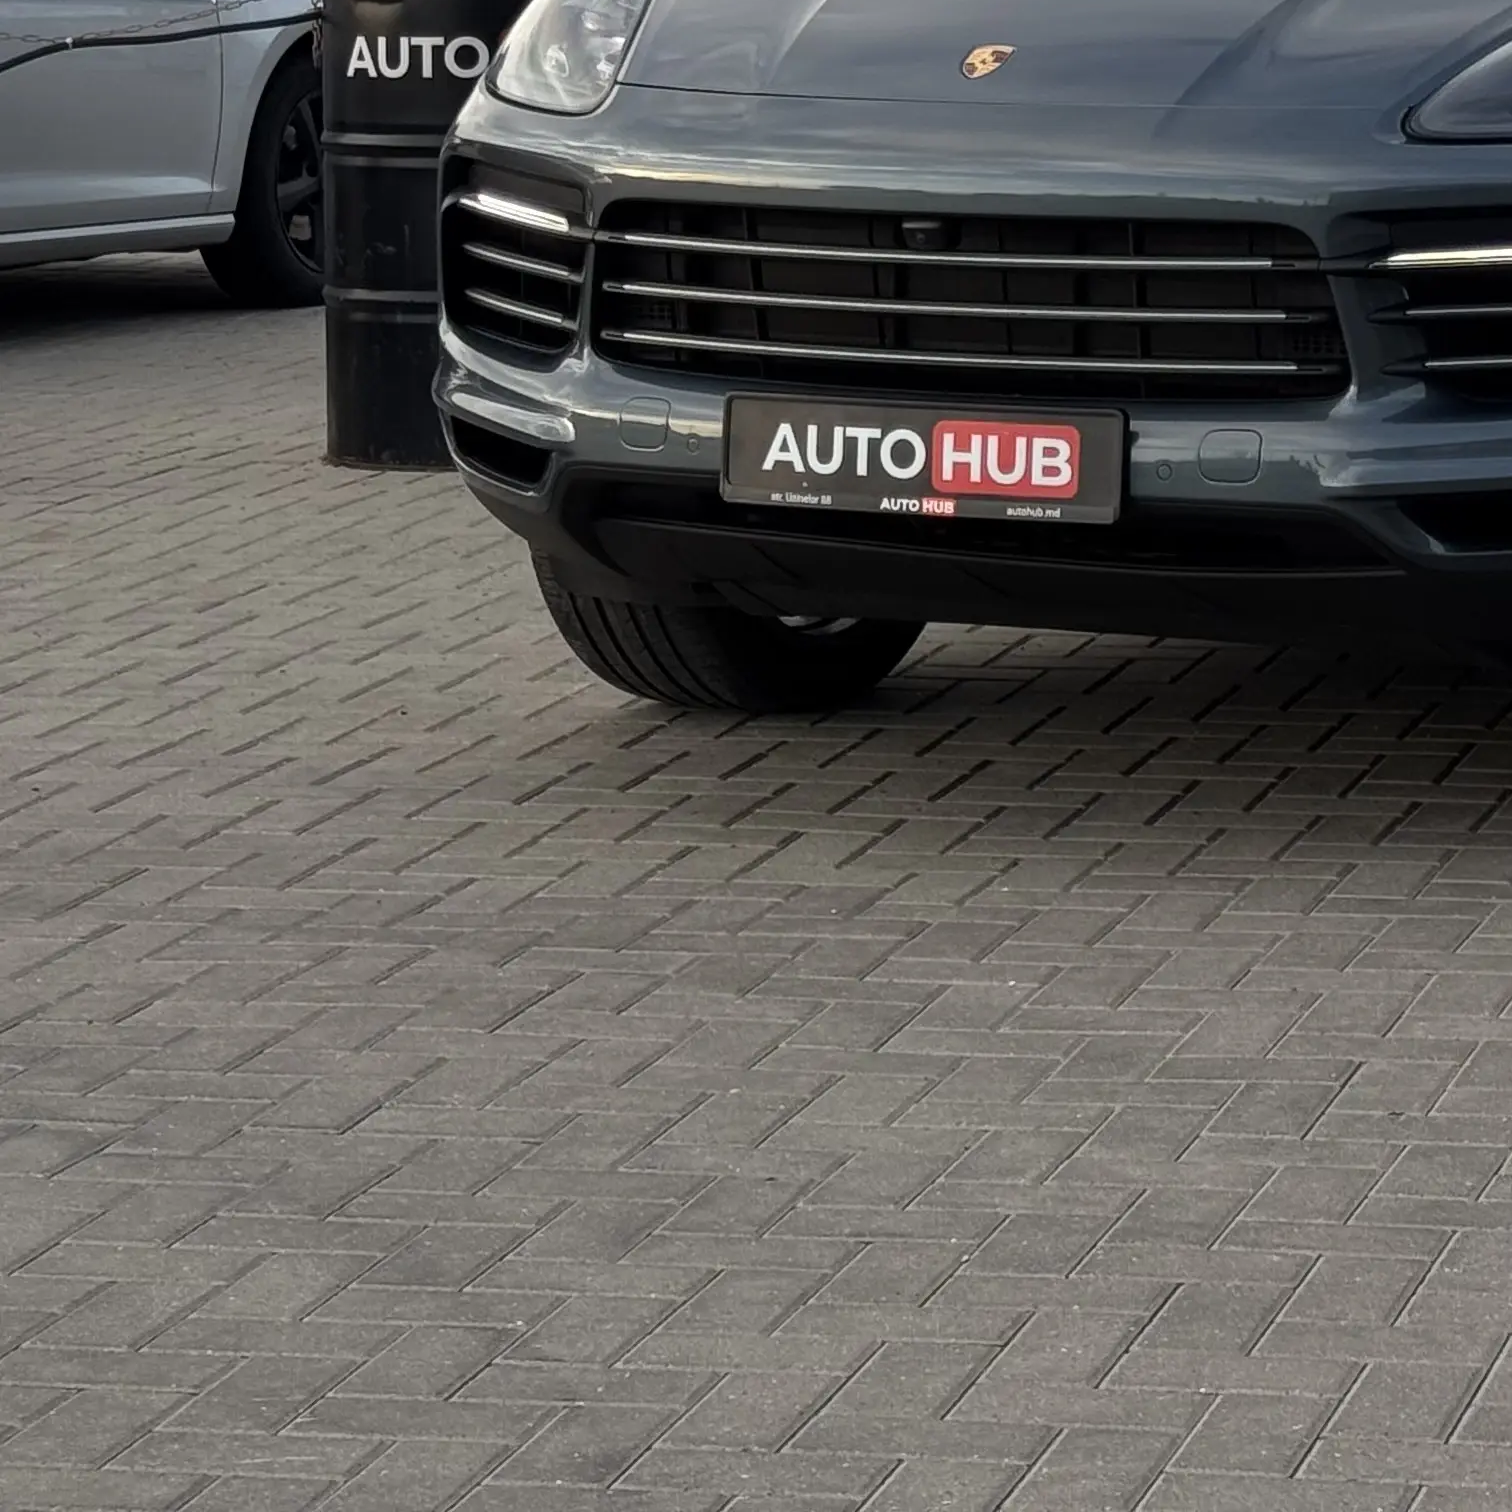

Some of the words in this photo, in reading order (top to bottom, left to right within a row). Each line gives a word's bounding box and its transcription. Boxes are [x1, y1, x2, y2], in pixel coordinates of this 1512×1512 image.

[346, 35, 490, 79] AUTO
[761, 422, 927, 480] AUTO
[942, 432, 1073, 487] HUB
[879, 497, 920, 513] AUTO
[922, 498, 955, 514] HUB
[1006, 506, 1062, 519] autohub.md
